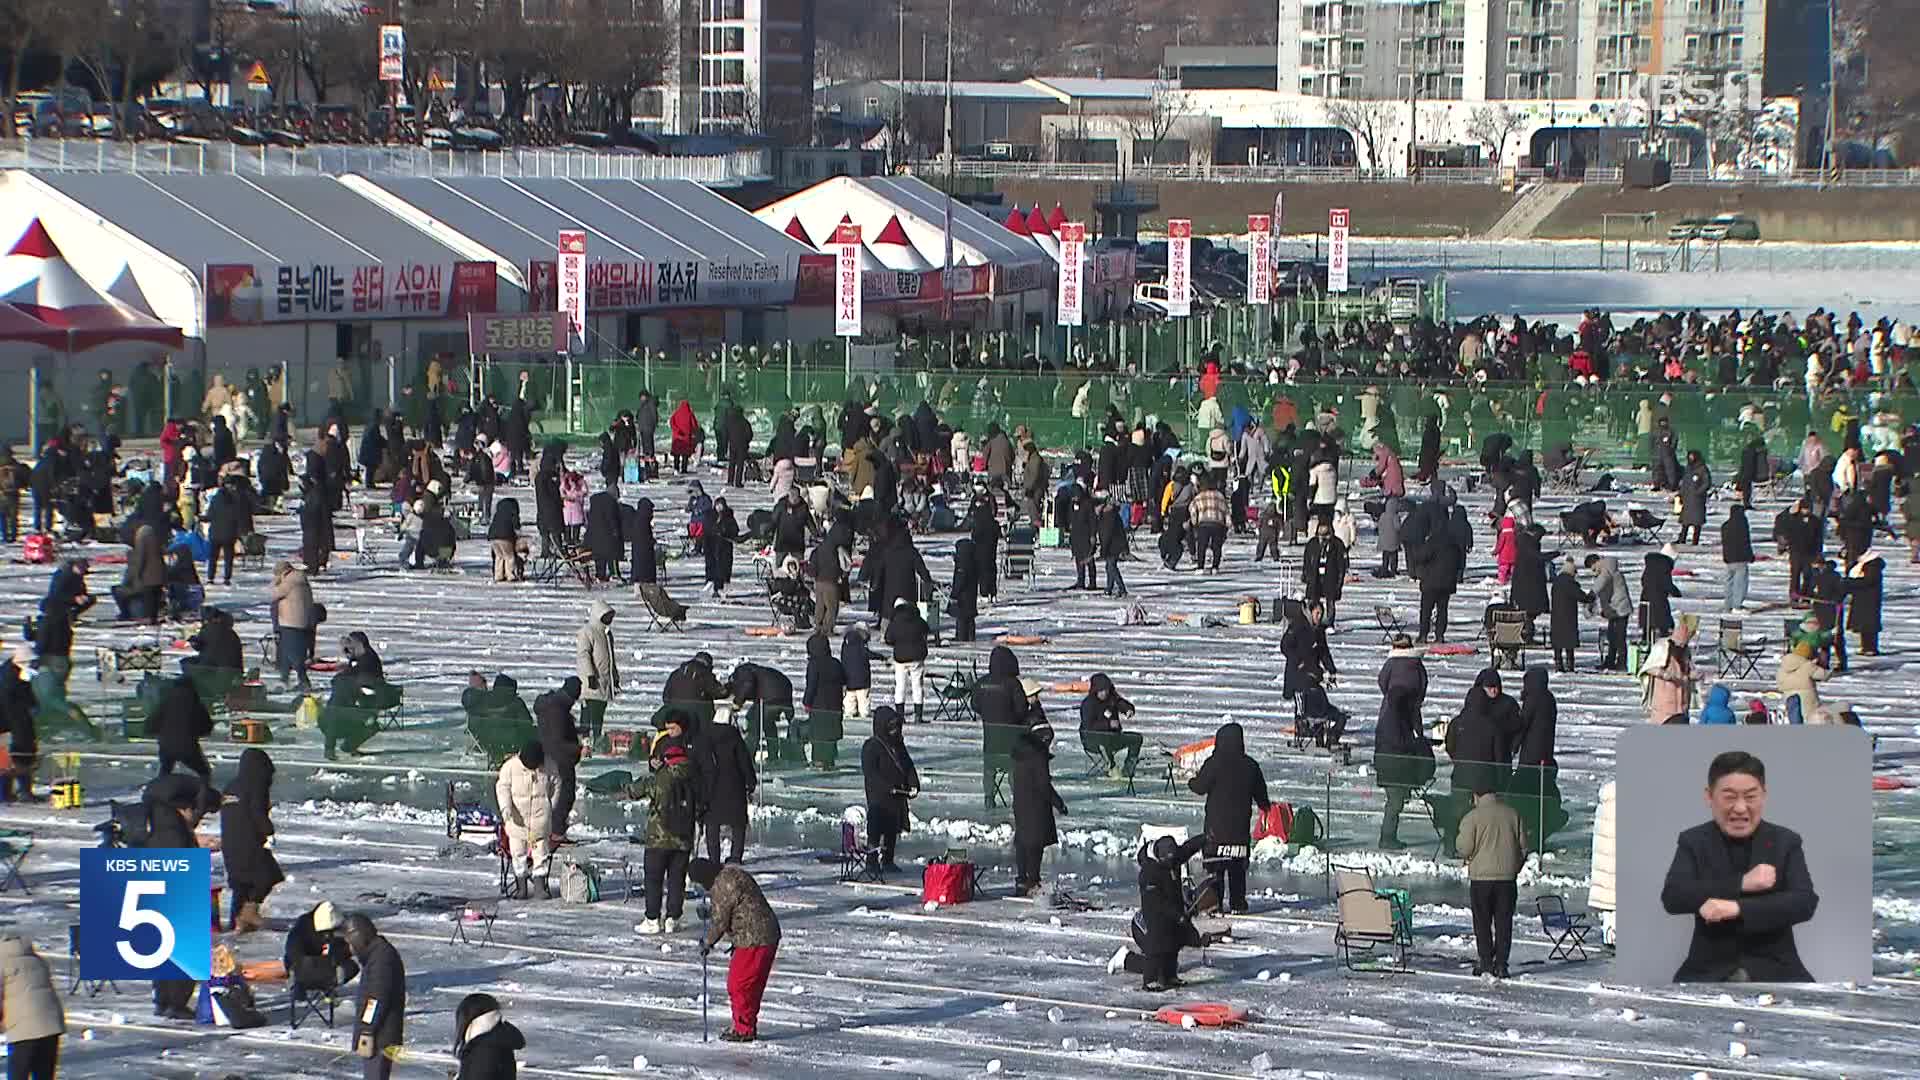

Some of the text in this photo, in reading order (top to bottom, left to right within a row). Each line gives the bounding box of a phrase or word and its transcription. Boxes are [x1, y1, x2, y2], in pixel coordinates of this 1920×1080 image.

[352, 264, 384, 313] 쉼터
[395, 263, 442, 312] 수유실
[657, 261, 699, 302] 접수처
[708, 262, 742, 281] Reserved
[743, 262, 754, 280] Ice
[754, 262, 780, 283] Fishing
